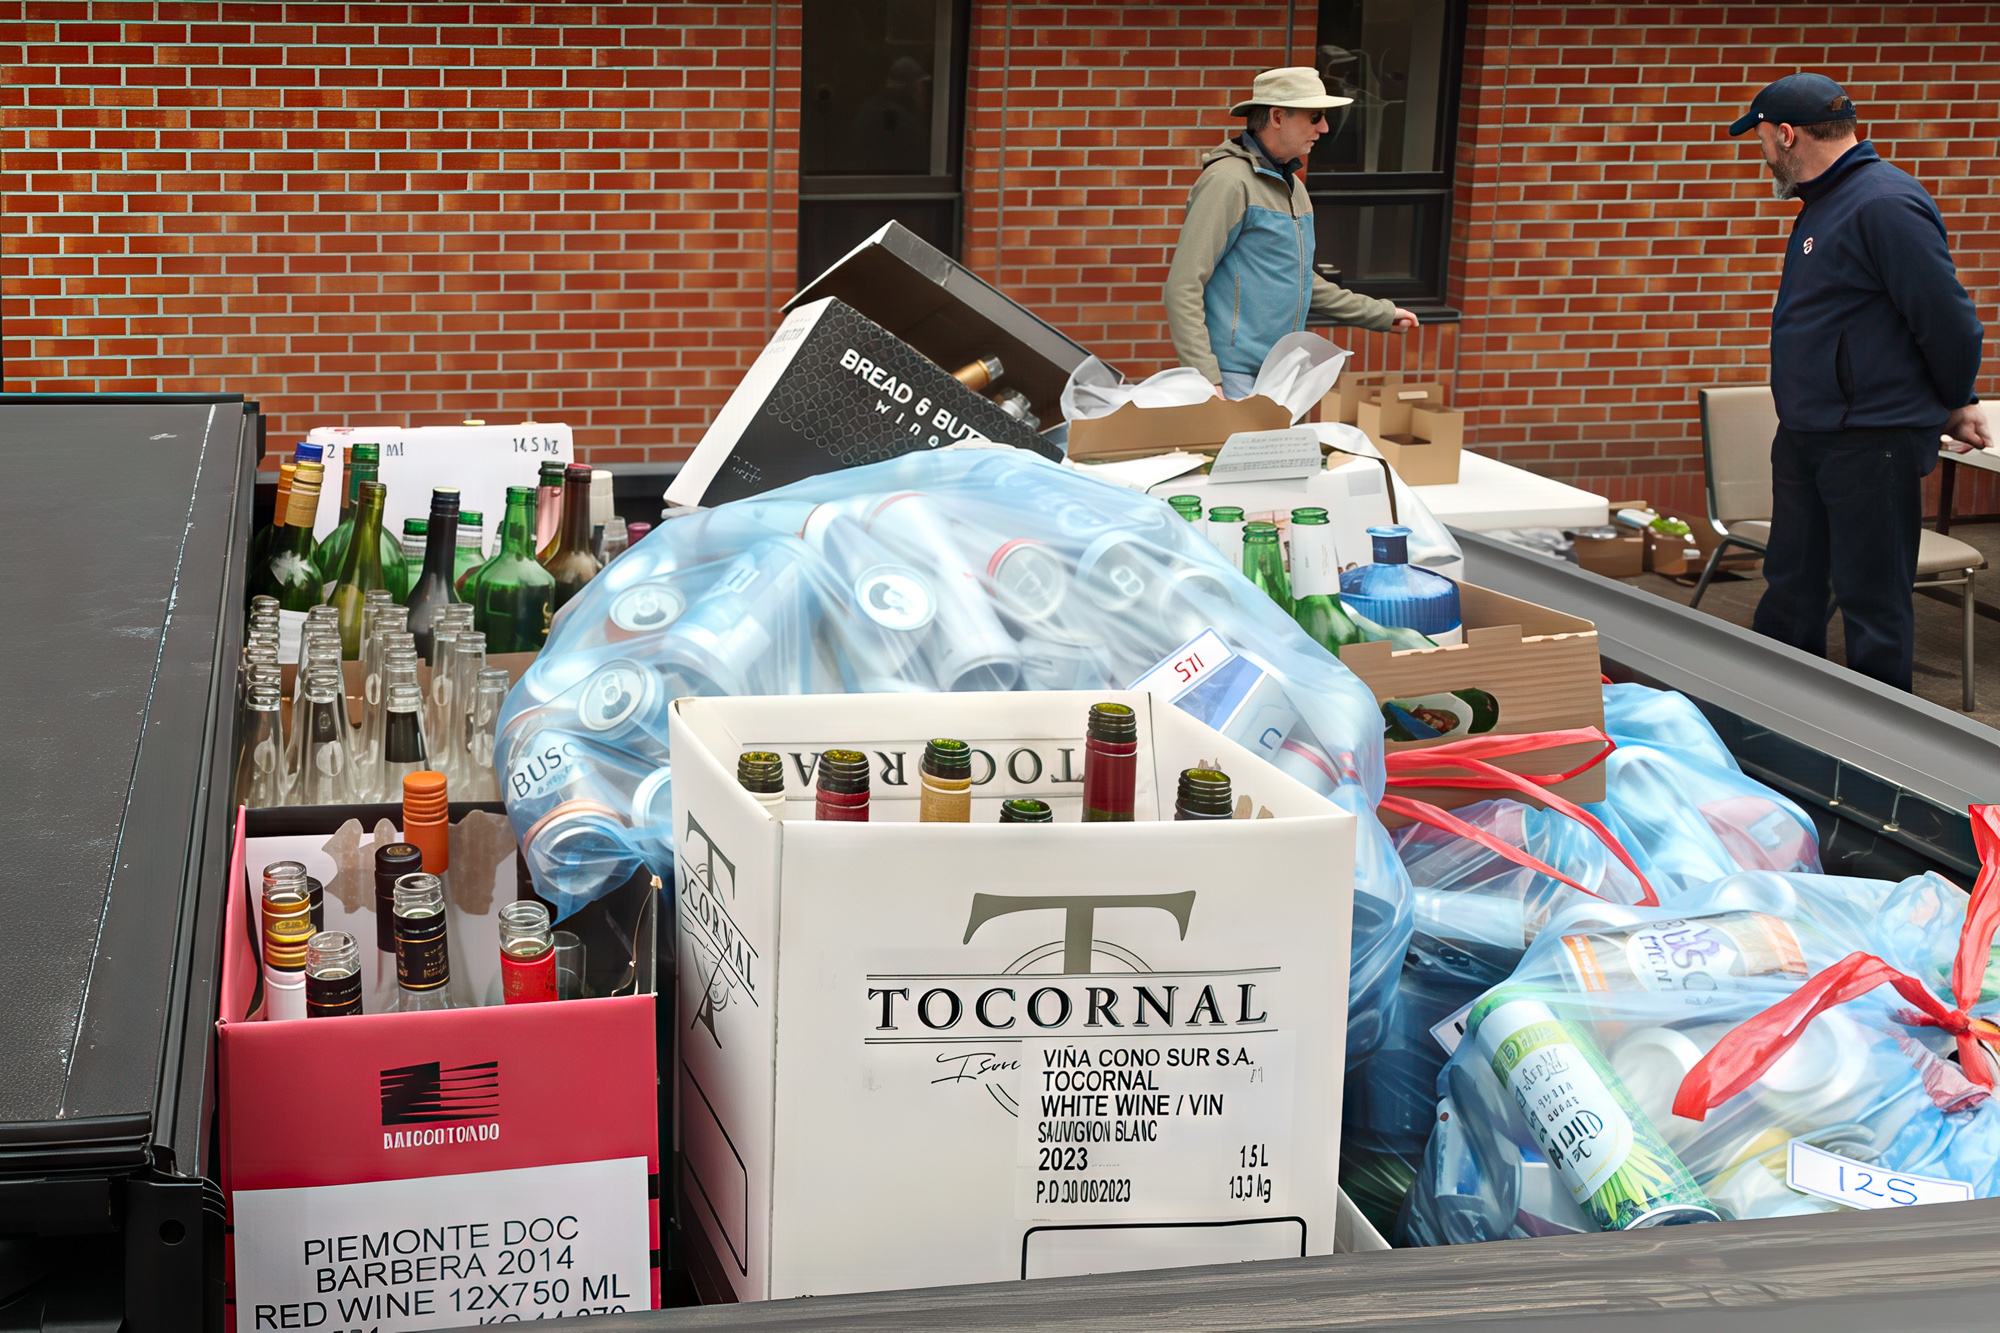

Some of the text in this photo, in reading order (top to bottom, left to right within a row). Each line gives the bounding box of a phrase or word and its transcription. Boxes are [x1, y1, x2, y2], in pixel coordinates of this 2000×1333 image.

[840, 348, 914, 404] BREAD
[931, 408, 993, 440] BUT
[867, 983, 1269, 1031] TOCORNAL
[1043, 1044, 1092, 1069] VIÑA
[1098, 1048, 1161, 1068] CONO
[1166, 1047, 1211, 1067] SUR
[1042, 1069, 1160, 1092] TOCORNAL
[1041, 1094, 1109, 1118] WHITE
[1115, 1093, 1170, 1116] WINE
[1189, 1093, 1224, 1116] VIN
[1115, 1119, 1158, 1142] BLANC
[1038, 1146, 1089, 1171] 2023
[304, 1215, 579, 1266] PIEMONTE DOC
[316, 1244, 574, 1294] BARBERA 2014
[255, 1273, 631, 1331] RED WINE 12X750 ML
